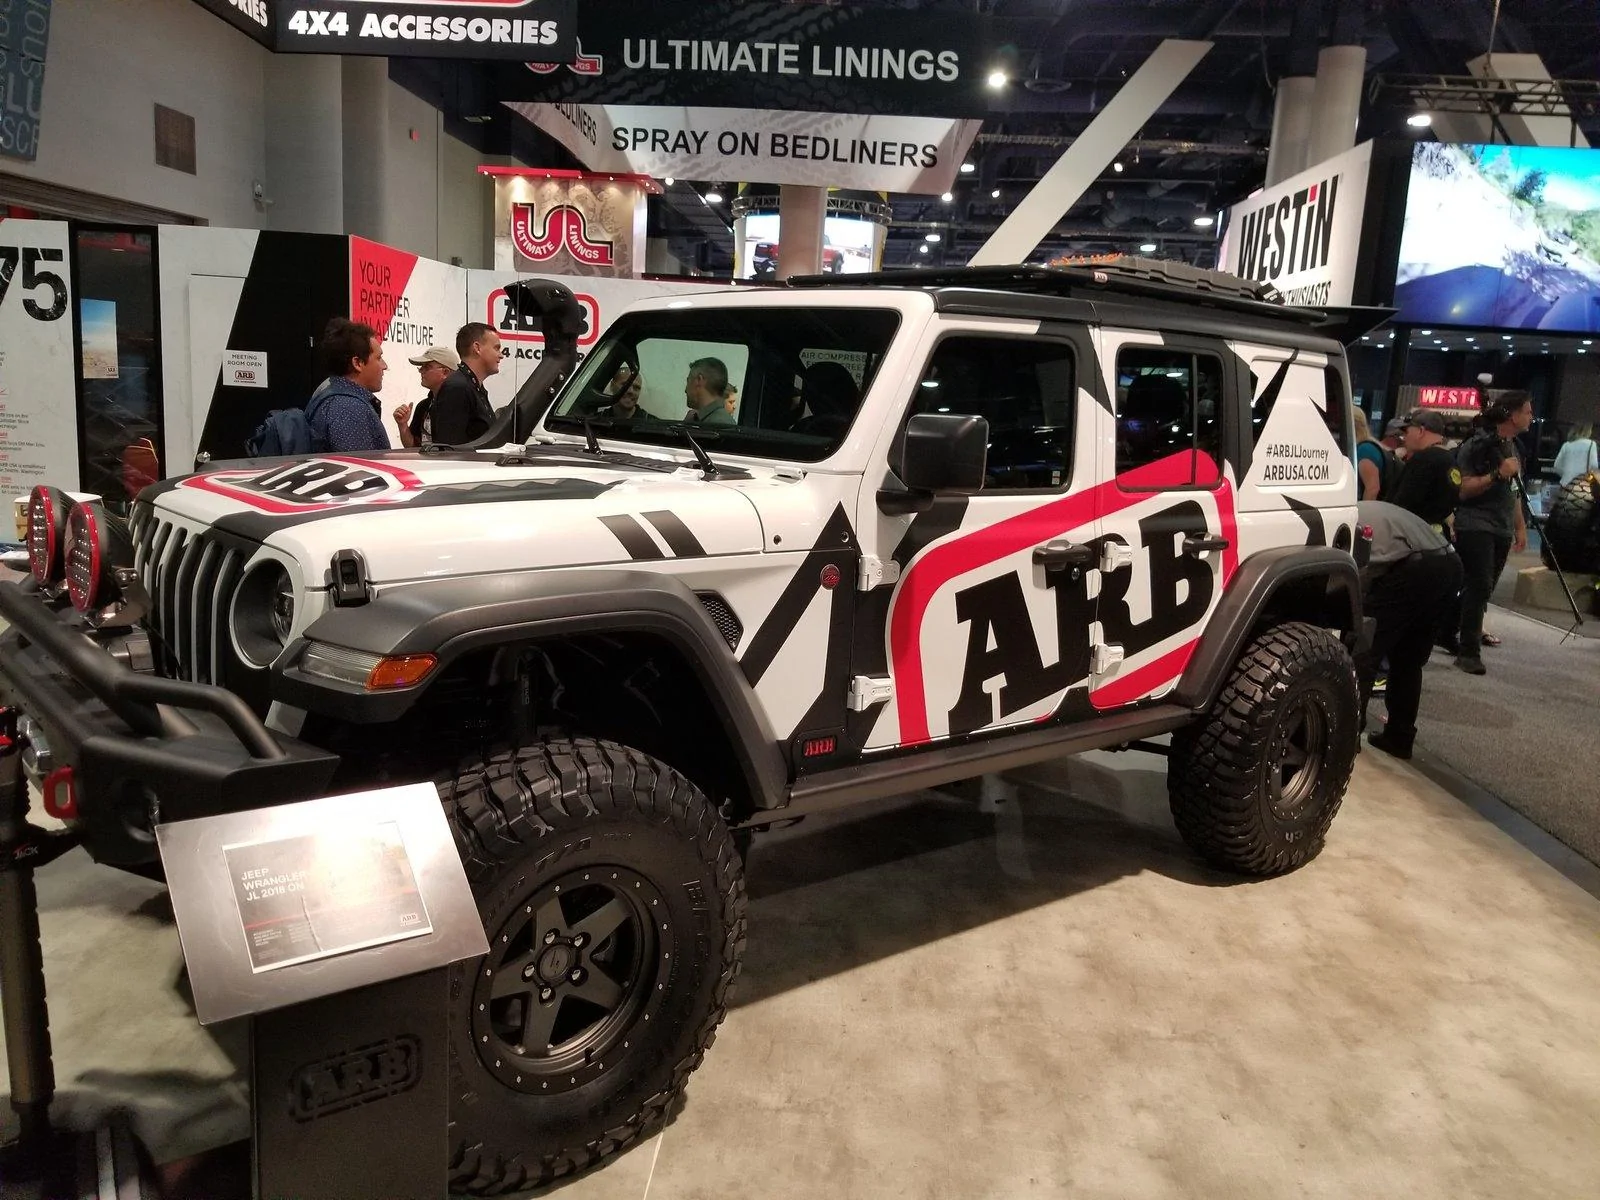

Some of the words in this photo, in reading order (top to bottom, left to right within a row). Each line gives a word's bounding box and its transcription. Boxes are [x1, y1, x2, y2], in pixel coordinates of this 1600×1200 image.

[288, 10, 349, 36] 4X4
[359, 13, 558, 45] ACCESSORIES
[623, 38, 800, 74] ULTIMATE
[812, 45, 960, 82] LININGS
[612, 127, 709, 154] SPRAY
[717, 131, 759, 157] ON
[770, 133, 939, 169] BEDLINERS
[516, 221, 556, 256] ULTIMATE
[569, 225, 600, 260] LININGS
[359, 258, 391, 289] YOUR
[360, 288, 411, 319] PARTNER
[375, 318, 434, 347] ADVENTURE
[237, 371, 254, 379] ARB
[1422, 389, 1477, 406] WESTi
[1264, 465, 1329, 481] ARBUSA.COM
[948, 500, 1214, 734] ARB
[241, 868, 269, 881] JEEP
[243, 870, 307, 891] WRANGLER
[246, 889, 260, 902] JL
[261, 885, 286, 898] 2018
[287, 880, 305, 892] ON
